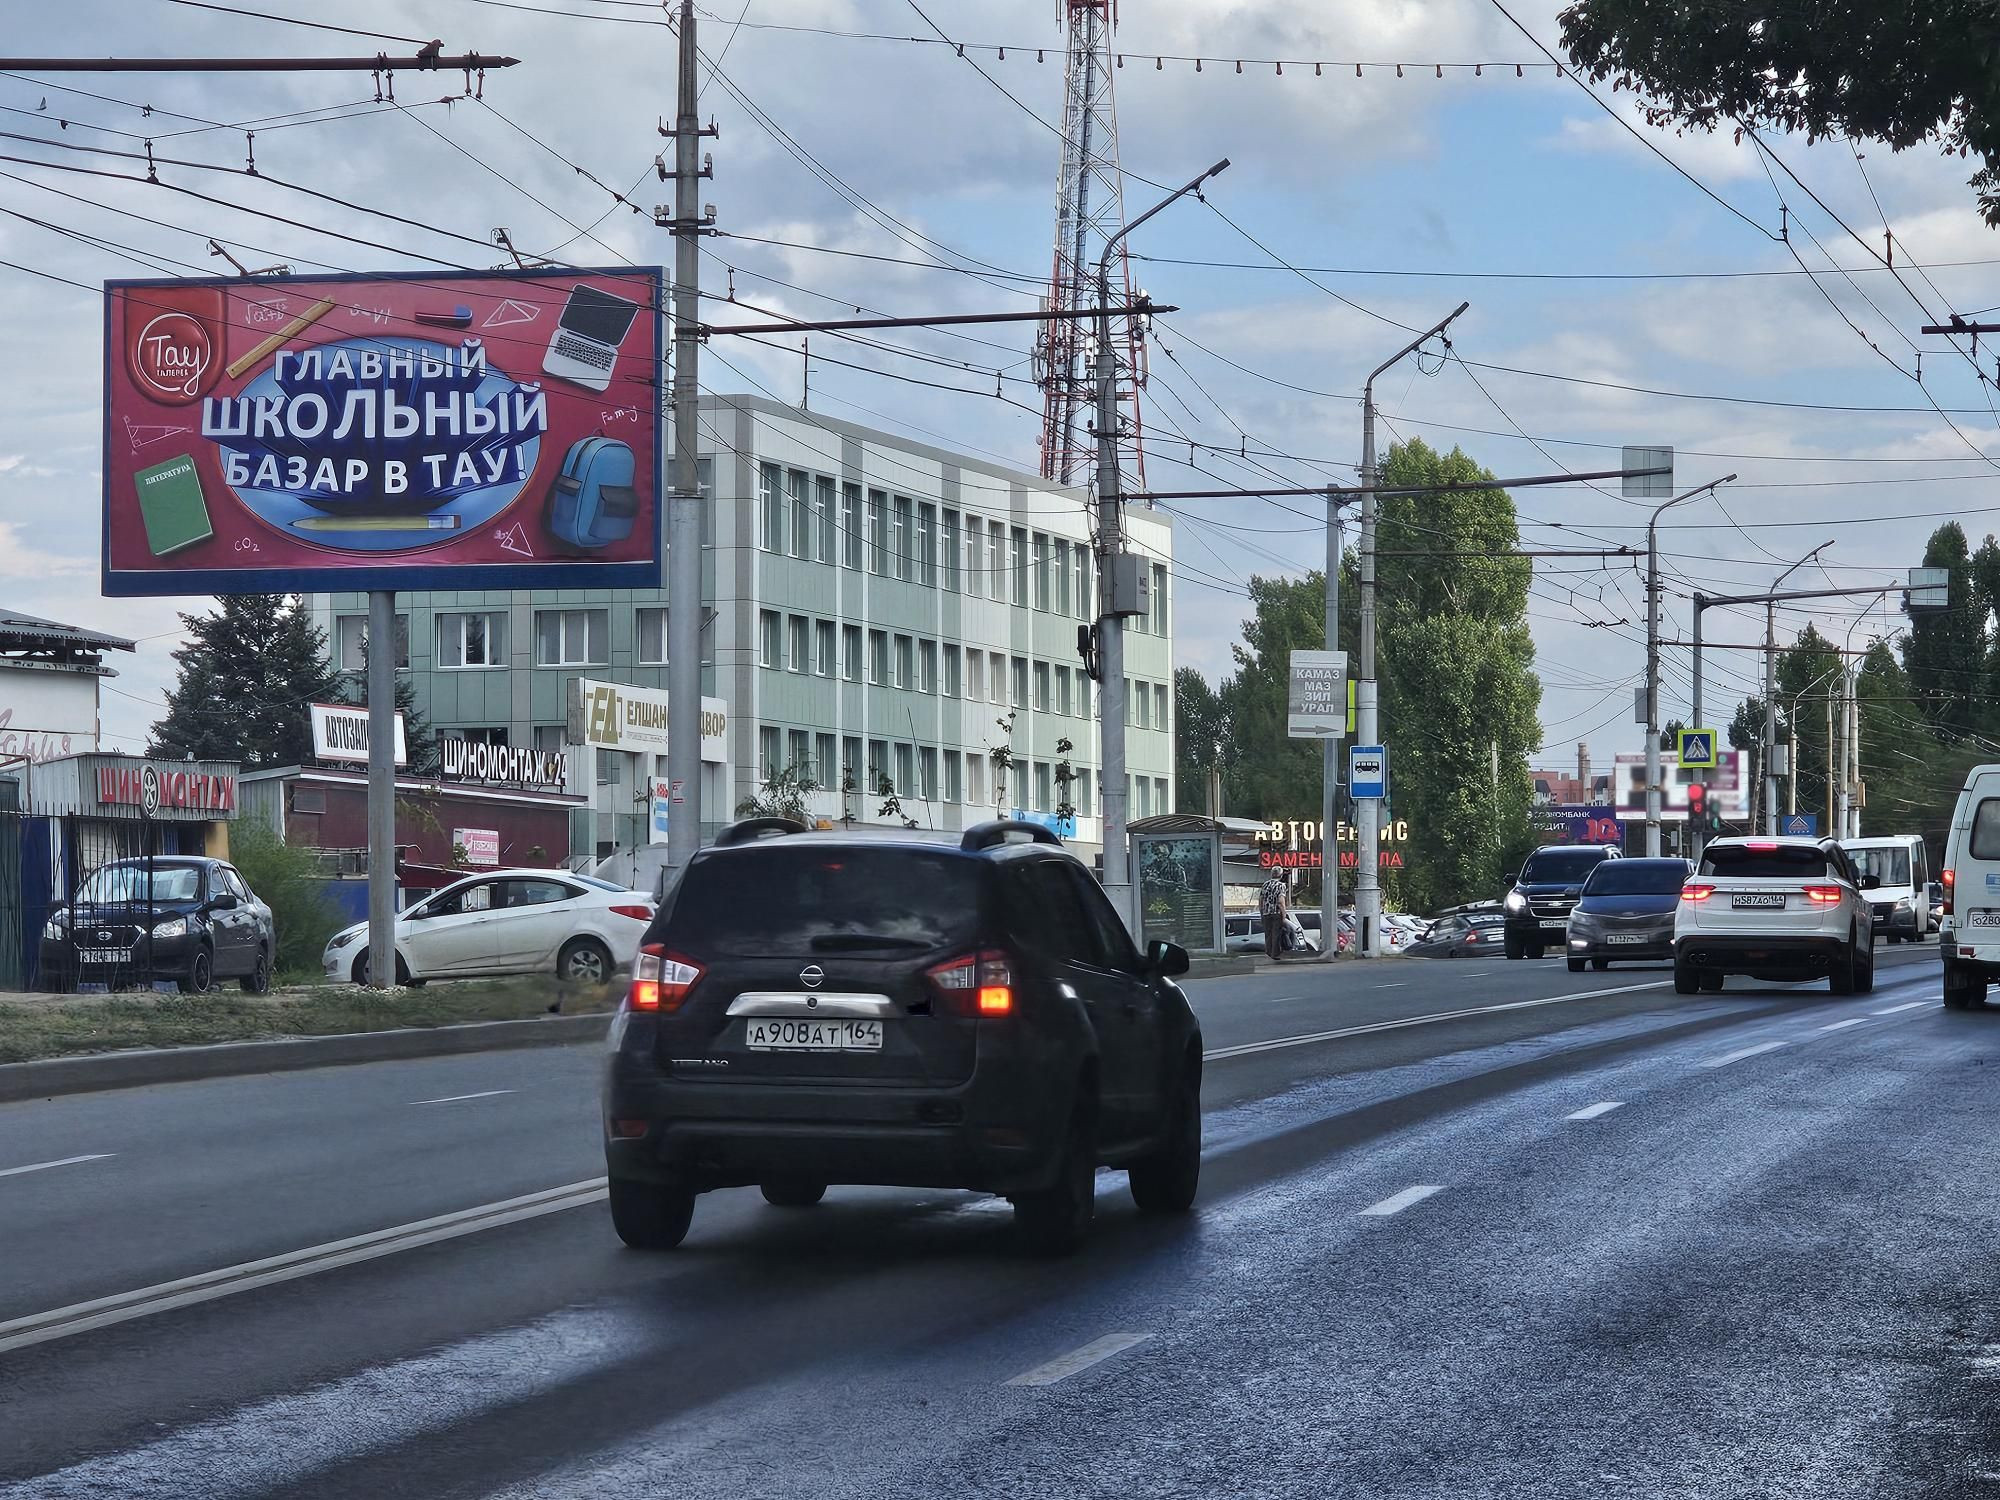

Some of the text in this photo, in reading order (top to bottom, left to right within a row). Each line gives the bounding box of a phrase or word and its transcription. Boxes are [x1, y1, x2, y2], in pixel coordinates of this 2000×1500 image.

[146, 334, 200, 396] Тау
[275, 338, 487, 381] ГЛАВНЫЙ
[202, 381, 548, 440] ШКОЛЬНЫЙ
[144, 464, 191, 485] ЛИТЕРАТУРА
[225, 444, 528, 494] БАЗАР В ТАУ!
[1296, 669, 1340, 680] КАМАЗ
[1304, 681, 1331, 691] МАЗ
[1300, 703, 1335, 713] УРАЛ
[1304, 691, 1331, 702] ЗИЛ
[627, 700, 667, 730] ЕЛШАН
[325, 714, 369, 751] АВТОЗАП
[444, 739, 547, 784] ШИНОМОНТАЖ
[1261, 852, 1403, 867] ЗАМЕН МЛА
[752, 1022, 880, 1045] А908АТ 164
